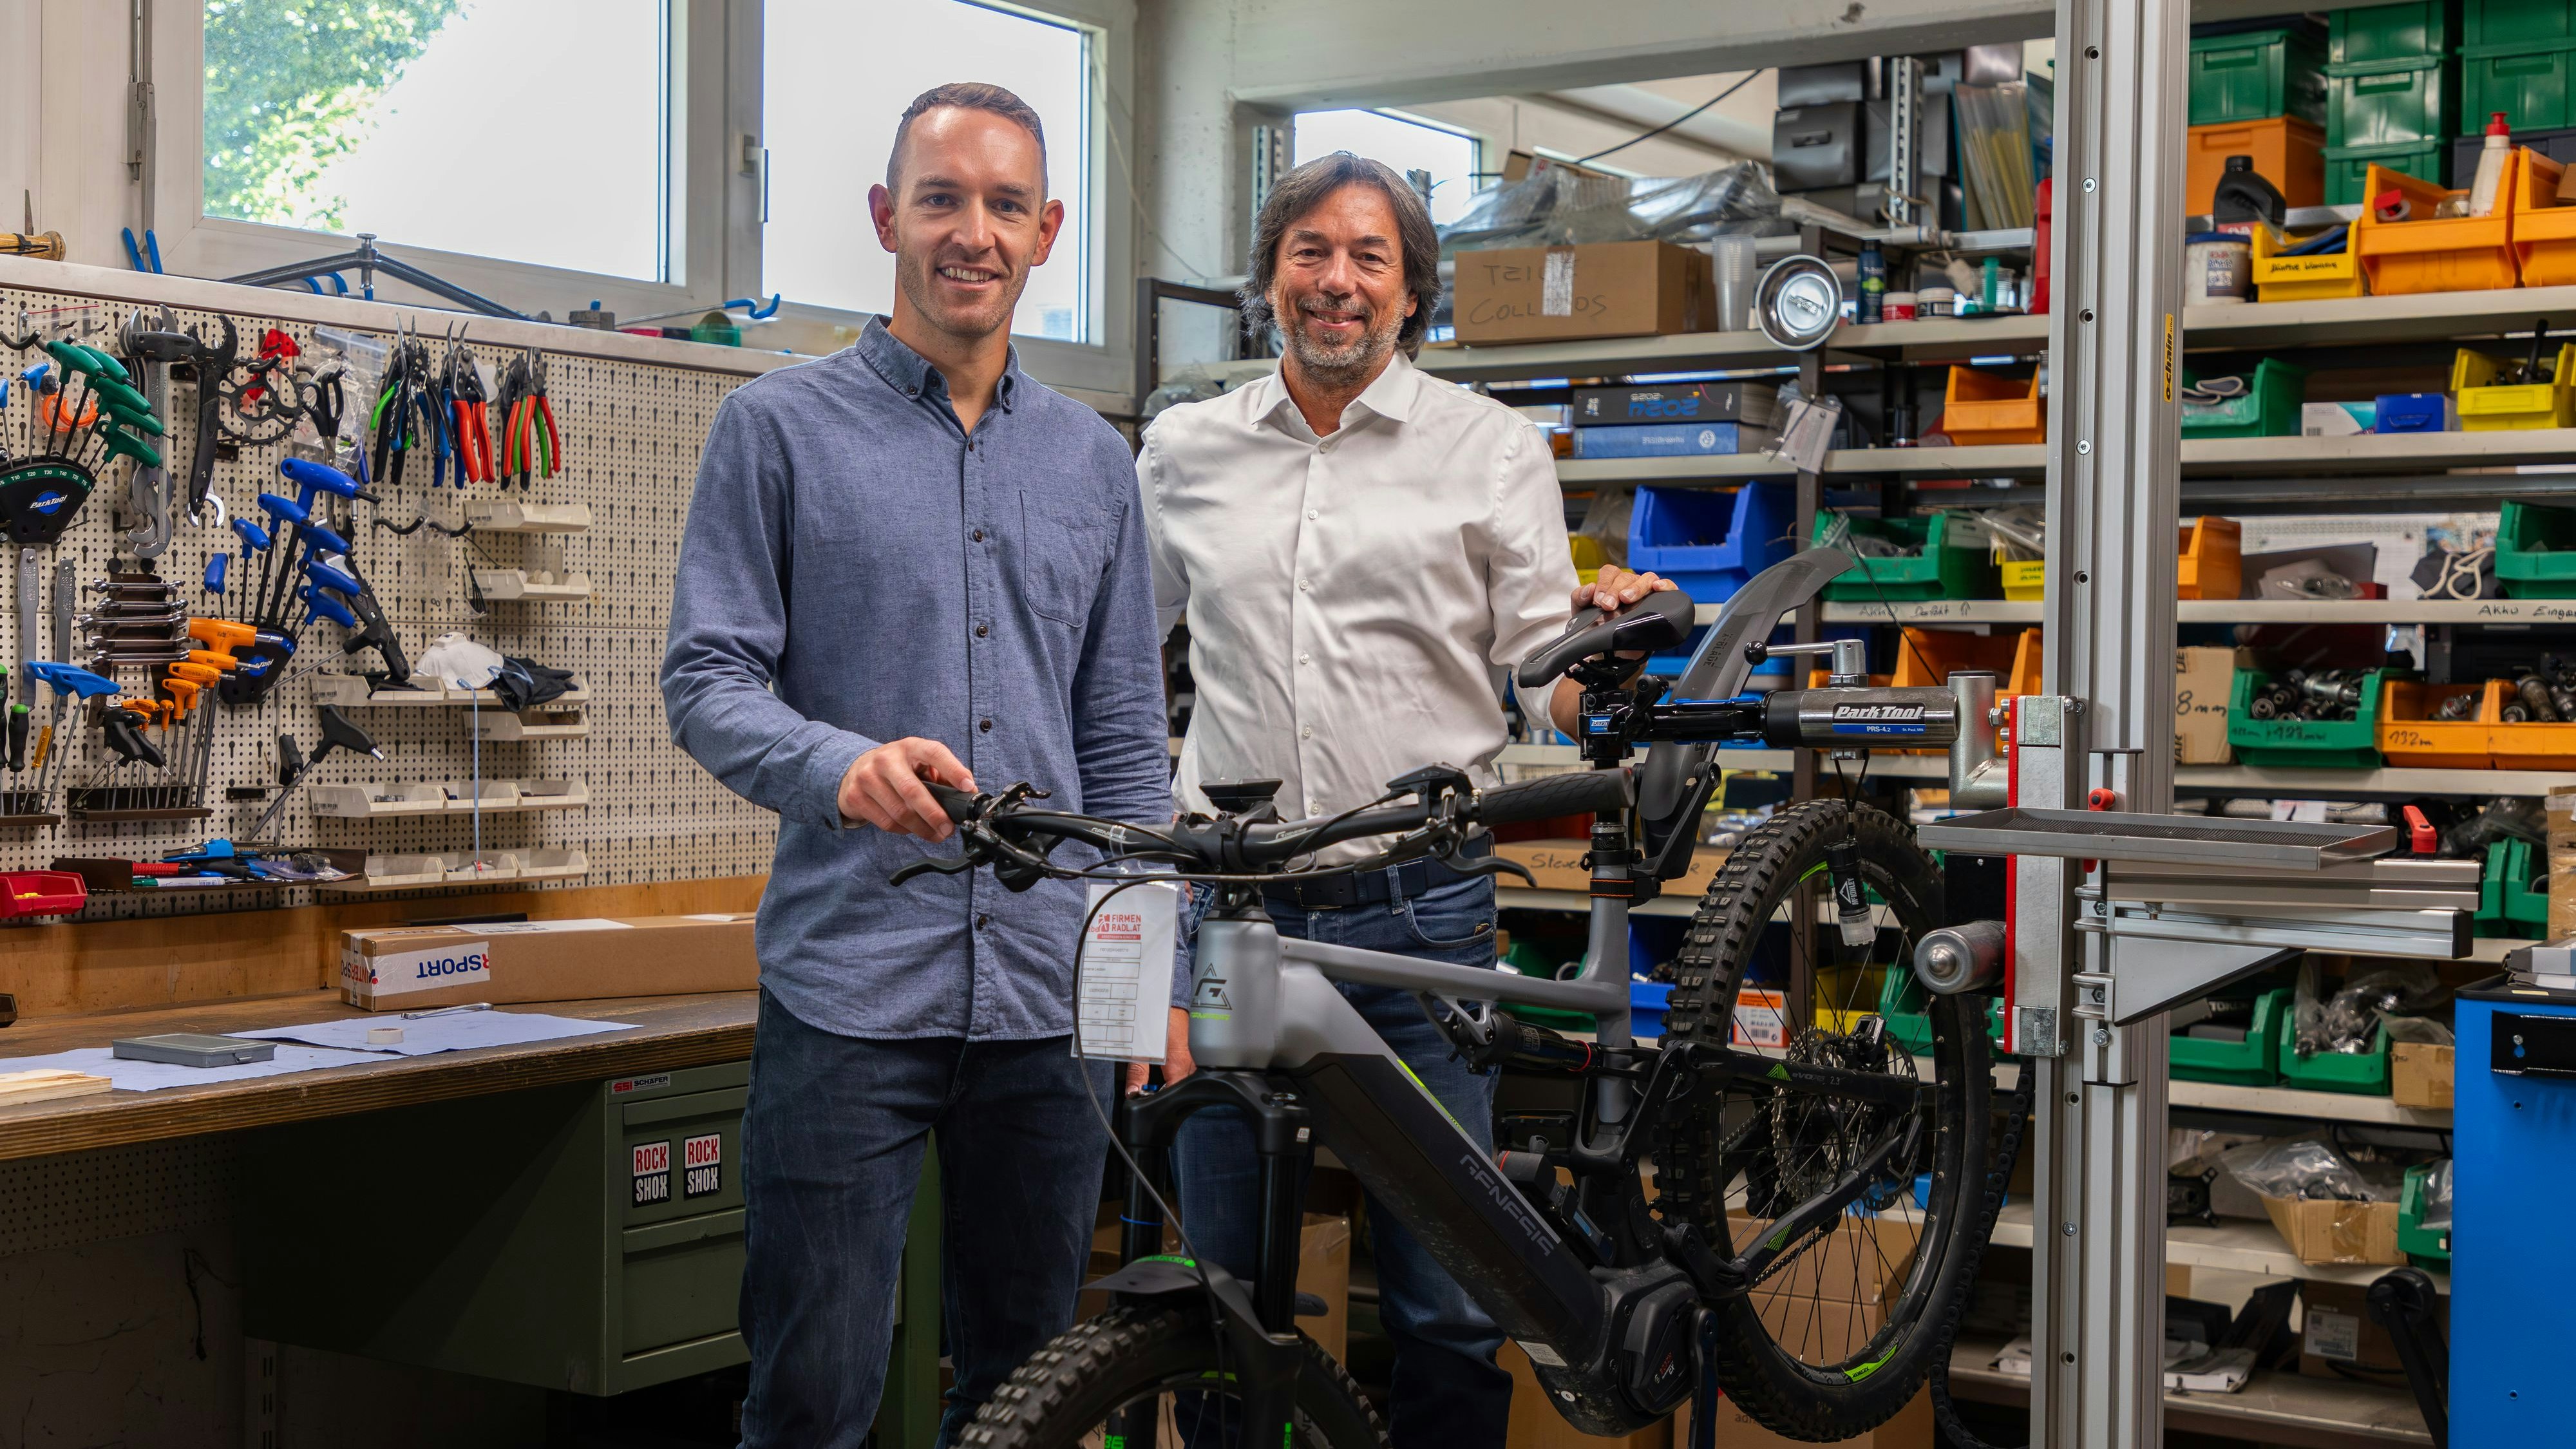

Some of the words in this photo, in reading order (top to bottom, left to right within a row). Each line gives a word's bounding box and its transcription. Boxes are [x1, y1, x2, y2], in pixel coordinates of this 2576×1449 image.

[1629, 398, 1700, 417] 2024
[1112, 914, 1141, 923] FIRMEN
[1112, 923, 1141, 932] RADL.AT
[613, 1081, 633, 1092] SSI
[636, 1146, 667, 1173] ROCK
[688, 1138, 718, 1165] ROCK
[636, 1174, 668, 1202] SHOX
[688, 1166, 718, 1194] SHOX
